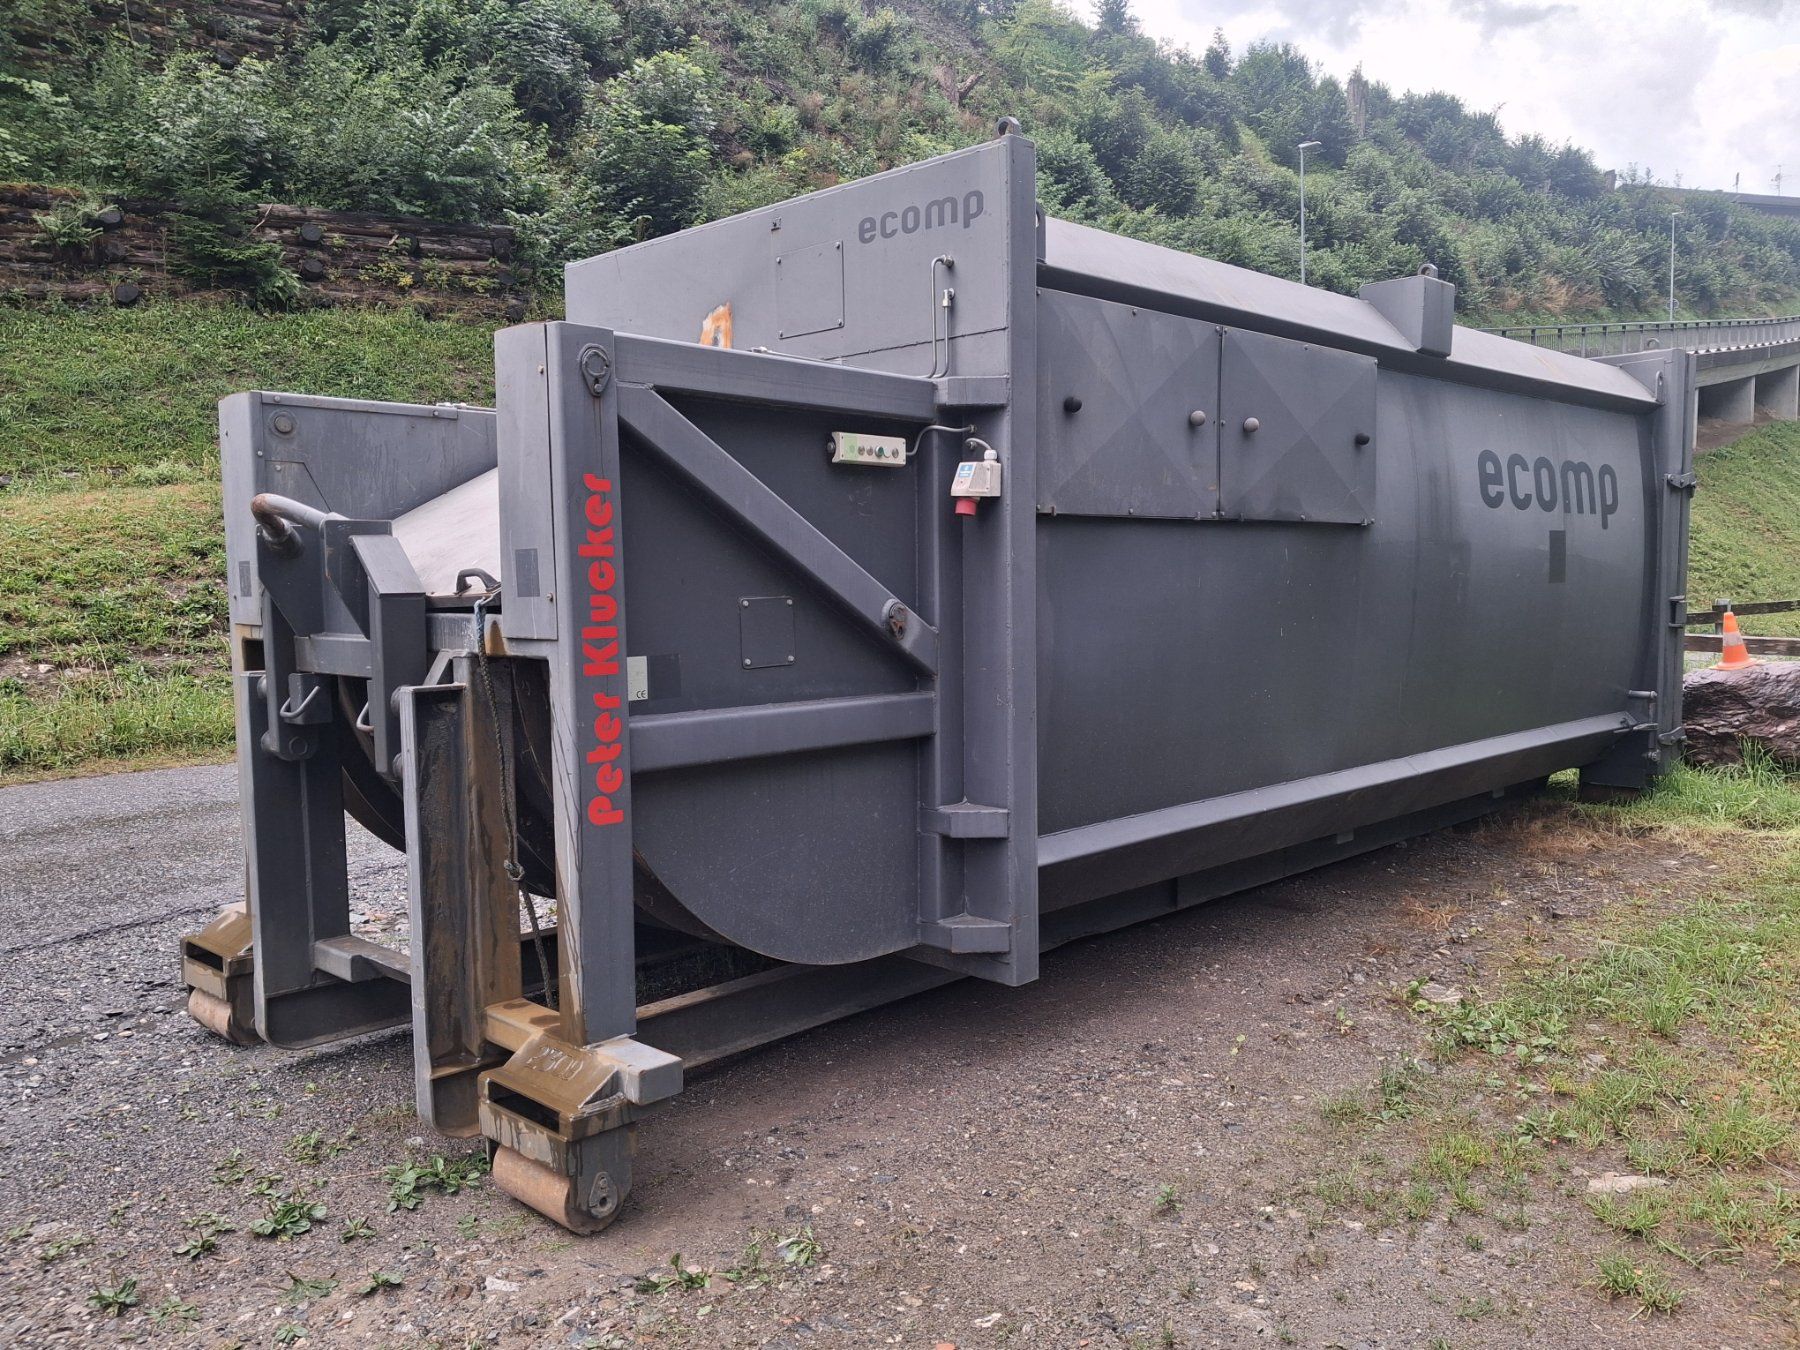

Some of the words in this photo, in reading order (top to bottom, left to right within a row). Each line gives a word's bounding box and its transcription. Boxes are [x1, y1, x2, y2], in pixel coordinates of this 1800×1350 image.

[858, 190, 984, 244] ecomp
[1477, 449, 1619, 530] ecomp
[577, 473, 620, 677] Klucker
[587, 692, 624, 826] Peter
